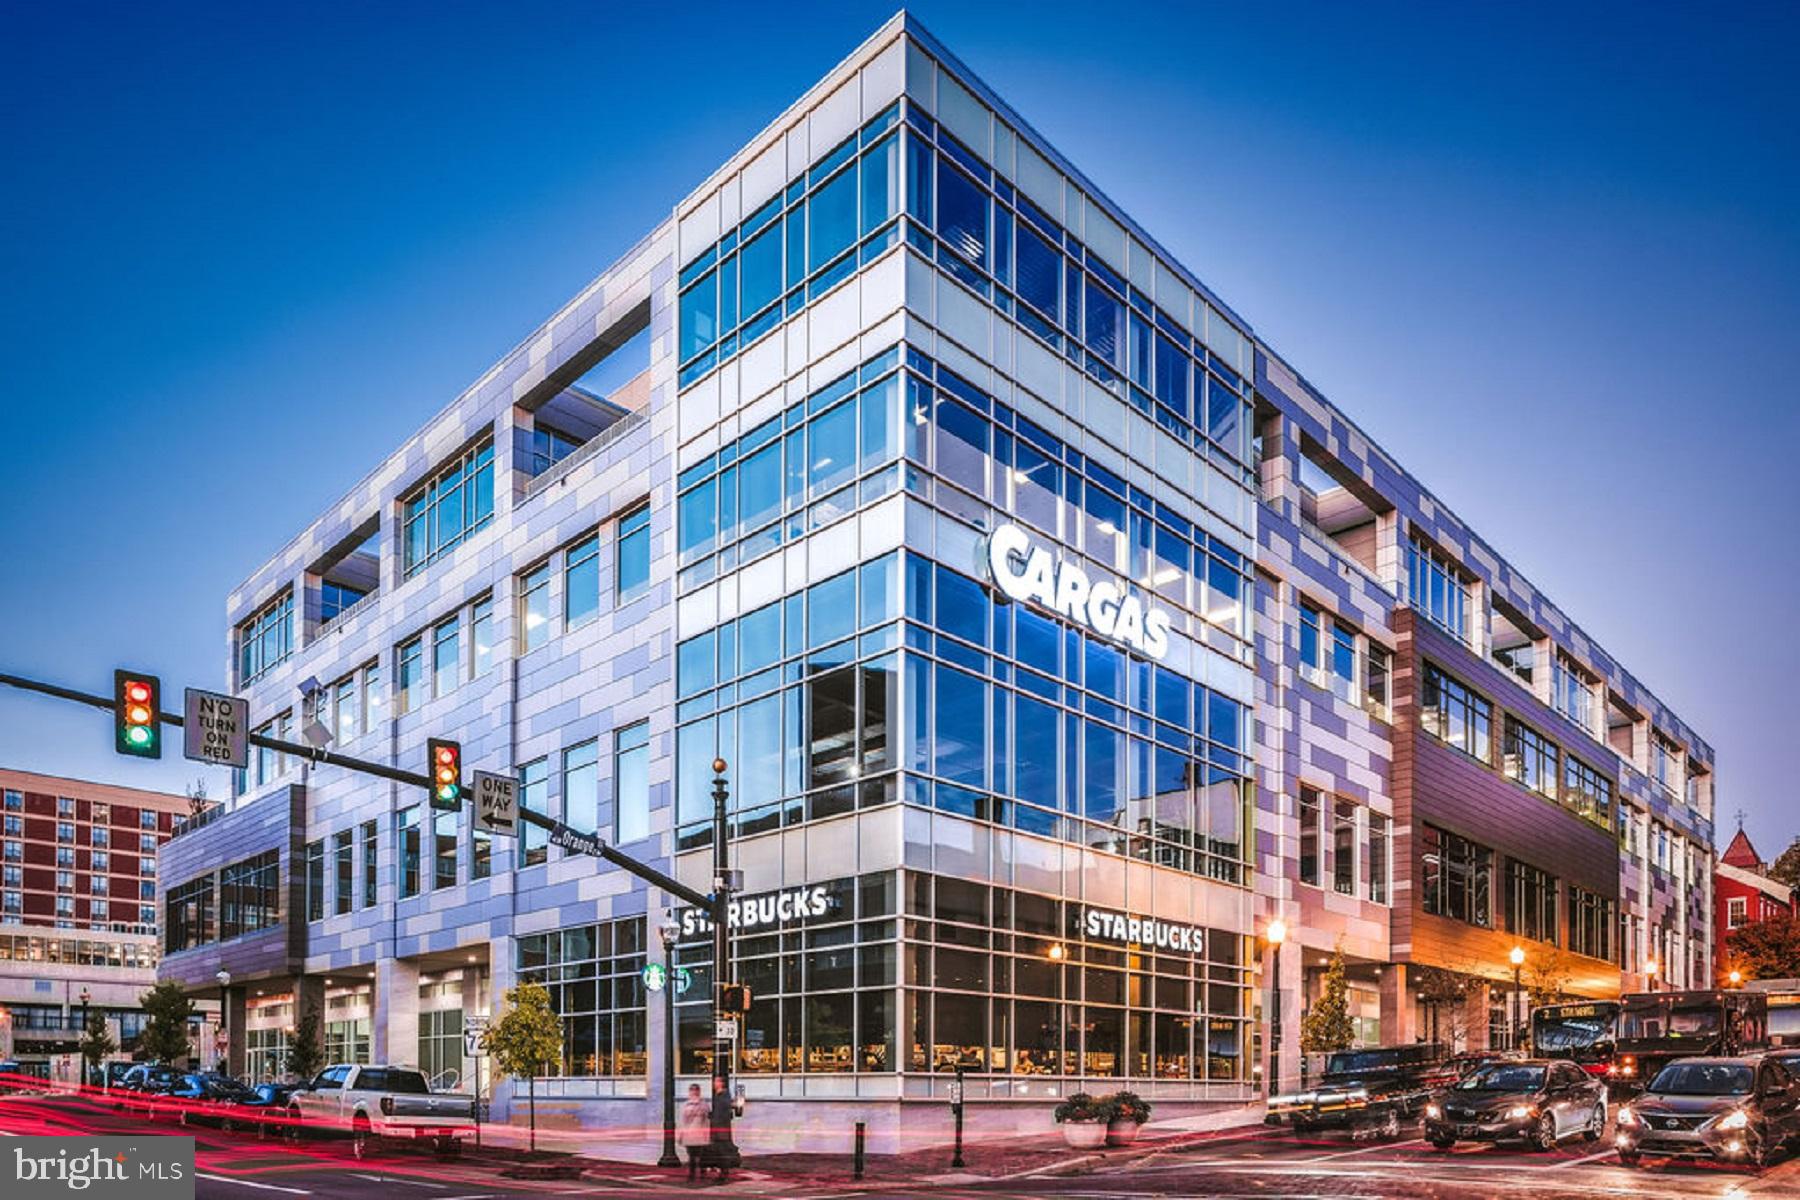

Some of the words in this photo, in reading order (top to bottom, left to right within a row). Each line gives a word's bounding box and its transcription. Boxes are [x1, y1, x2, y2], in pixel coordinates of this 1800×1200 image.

[989, 524, 1171, 660] CARGAS
[200, 697, 232, 716] NO
[198, 714, 236, 733] TURN
[206, 732, 228, 745] ON
[203, 745, 231, 760] RED
[482, 777, 512, 796] ONE
[482, 794, 512, 812] WAY
[563, 830, 594, 853] Orange
[1087, 909, 1203, 953] STARBUCKS
